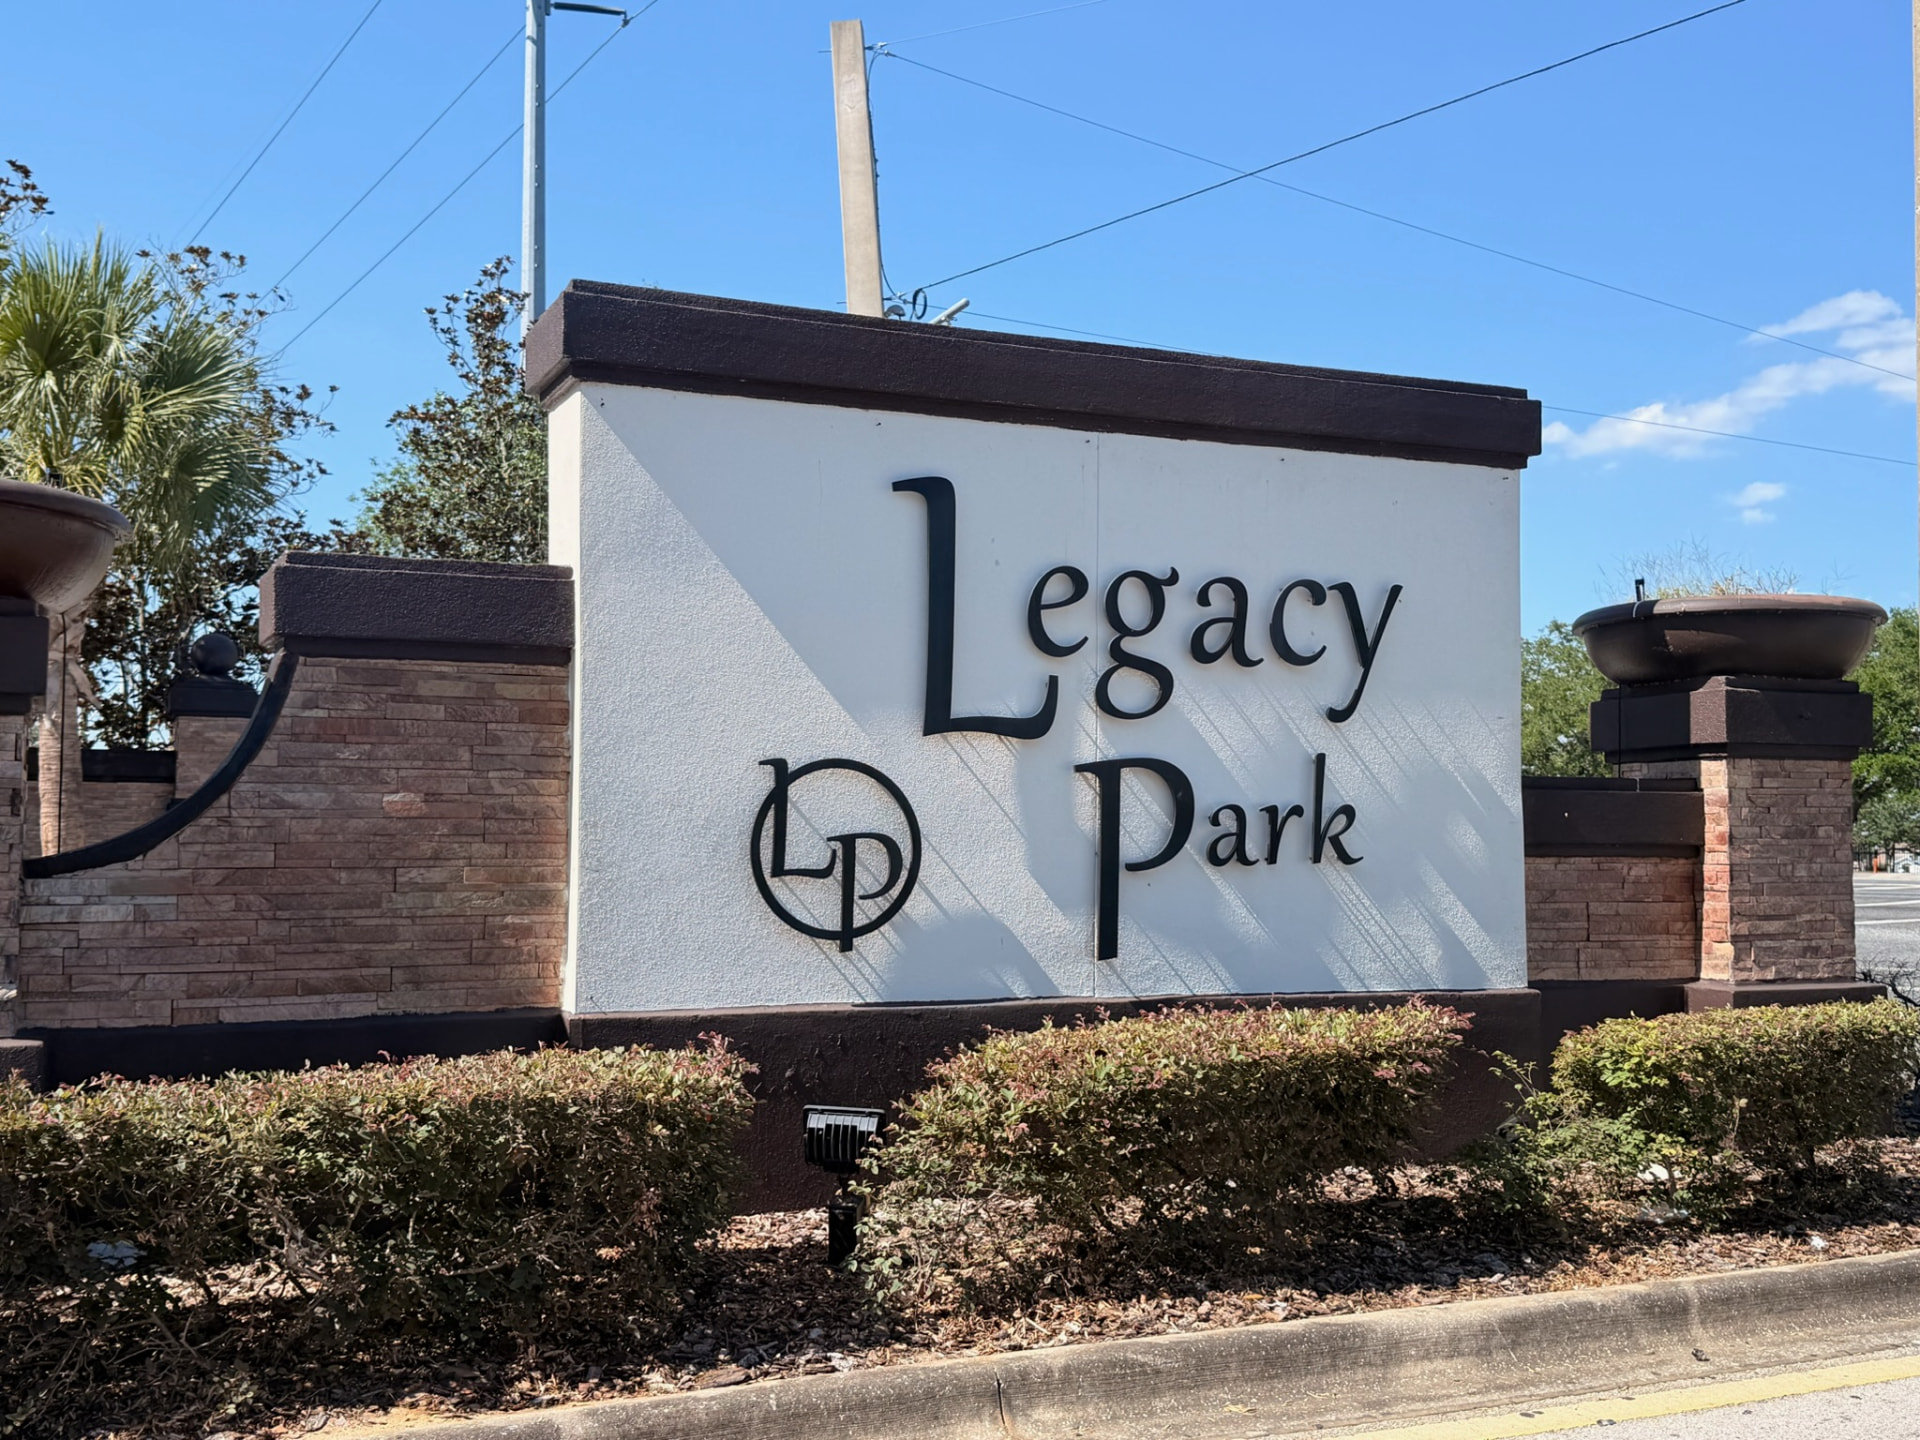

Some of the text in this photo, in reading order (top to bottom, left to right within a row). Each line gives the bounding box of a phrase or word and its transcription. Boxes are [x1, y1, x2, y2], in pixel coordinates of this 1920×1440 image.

[891, 476, 1404, 740] Legacy
[757, 757, 904, 953] LP
[1074, 753, 1364, 961] Park
